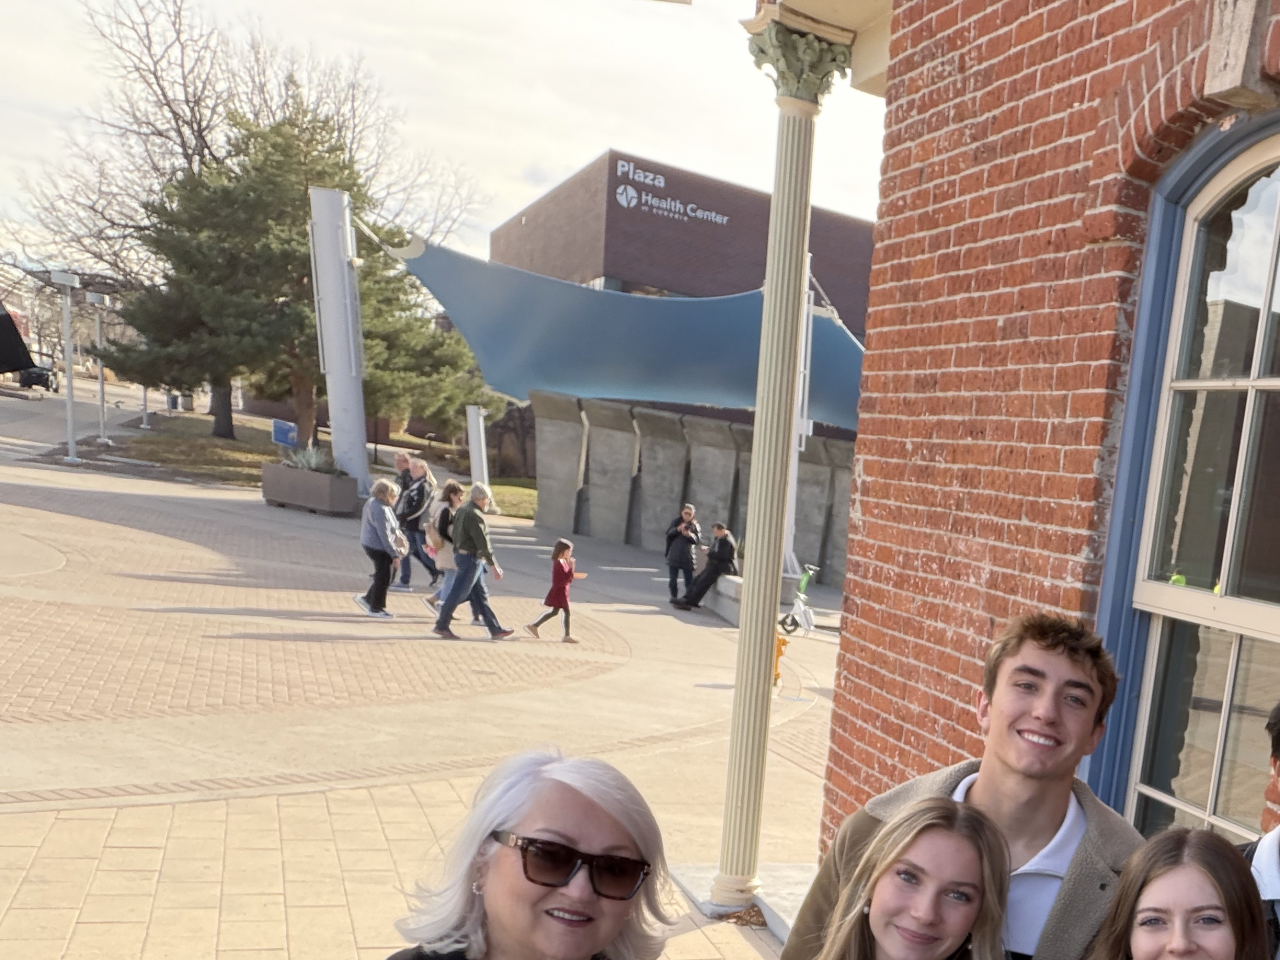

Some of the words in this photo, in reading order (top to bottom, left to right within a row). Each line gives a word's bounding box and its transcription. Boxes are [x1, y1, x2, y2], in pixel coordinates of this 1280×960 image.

[616, 159, 666, 189] Plaza
[641, 190, 685, 214] Health
[686, 203, 729, 226] Center
